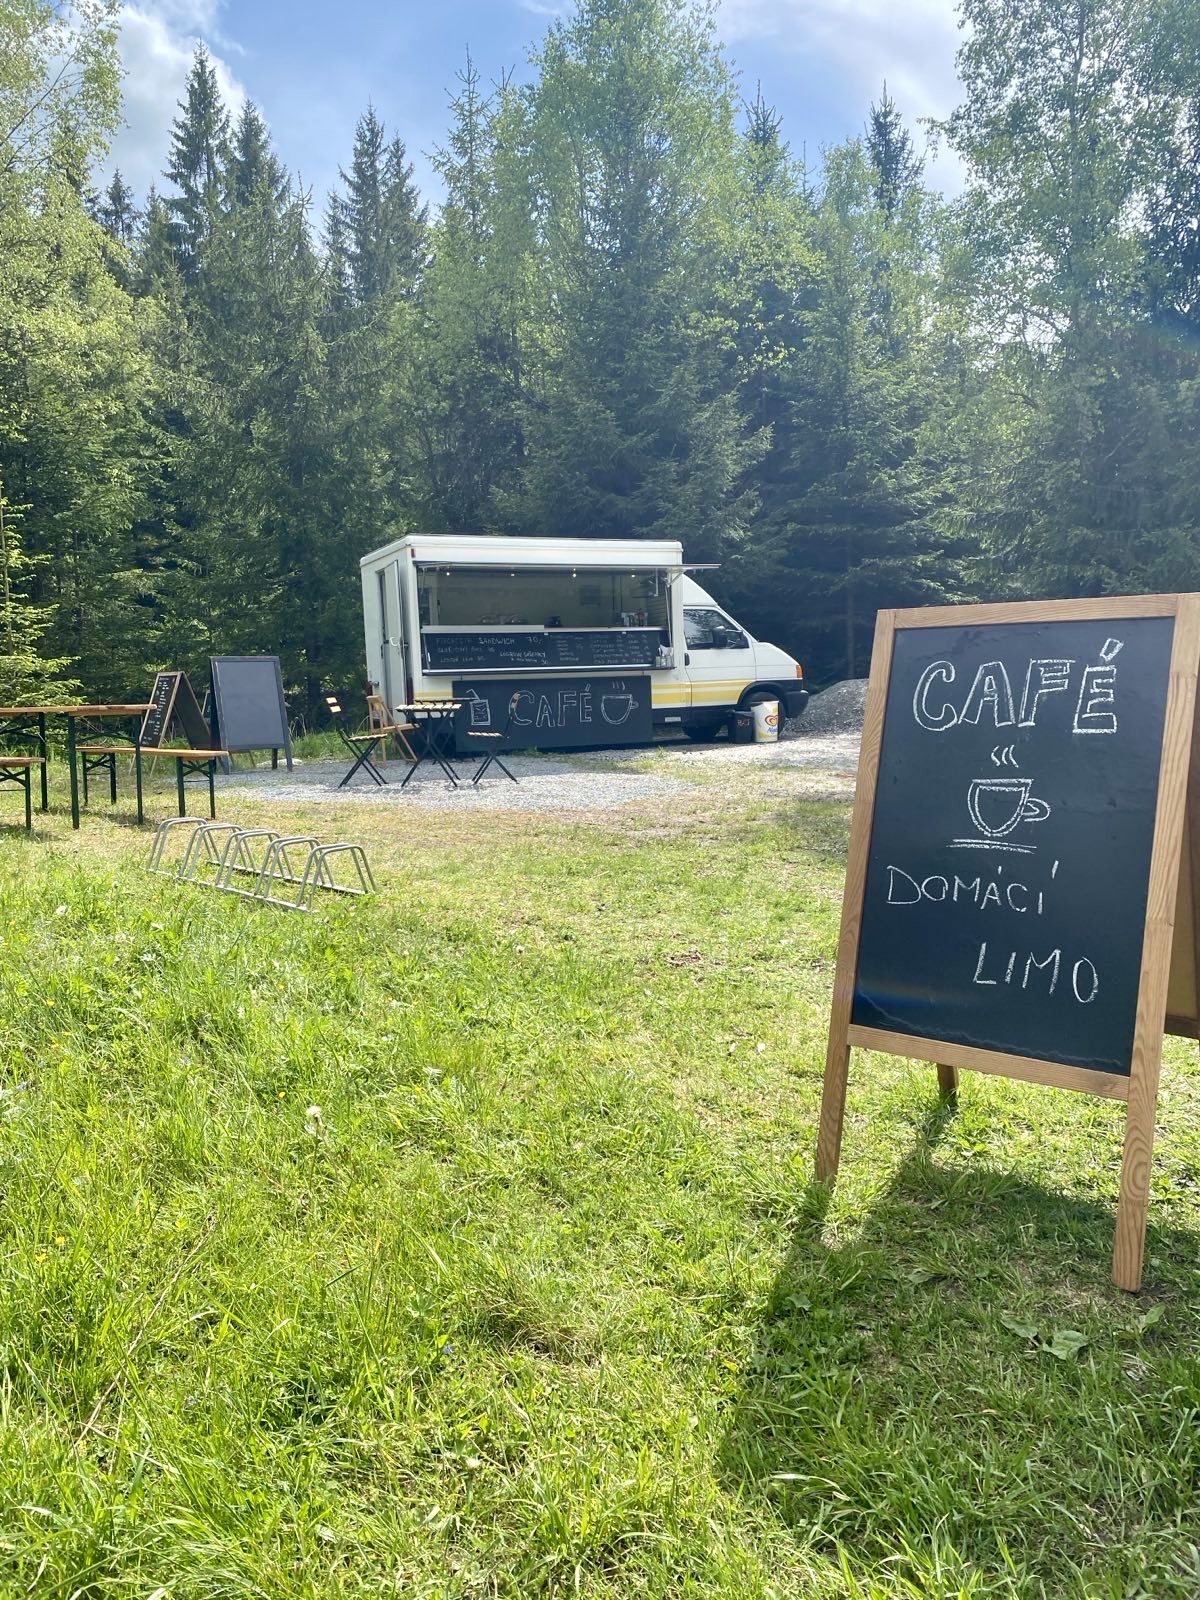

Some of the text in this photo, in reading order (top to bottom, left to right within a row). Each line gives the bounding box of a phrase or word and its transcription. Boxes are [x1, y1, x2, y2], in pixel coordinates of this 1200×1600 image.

[508, 683, 592, 728] CAFÉ
[913, 638, 1123, 734] CAFÉ
[886, 859, 1060, 914] DOMÁCÍ
[973, 942, 1100, 1003] LIMO
